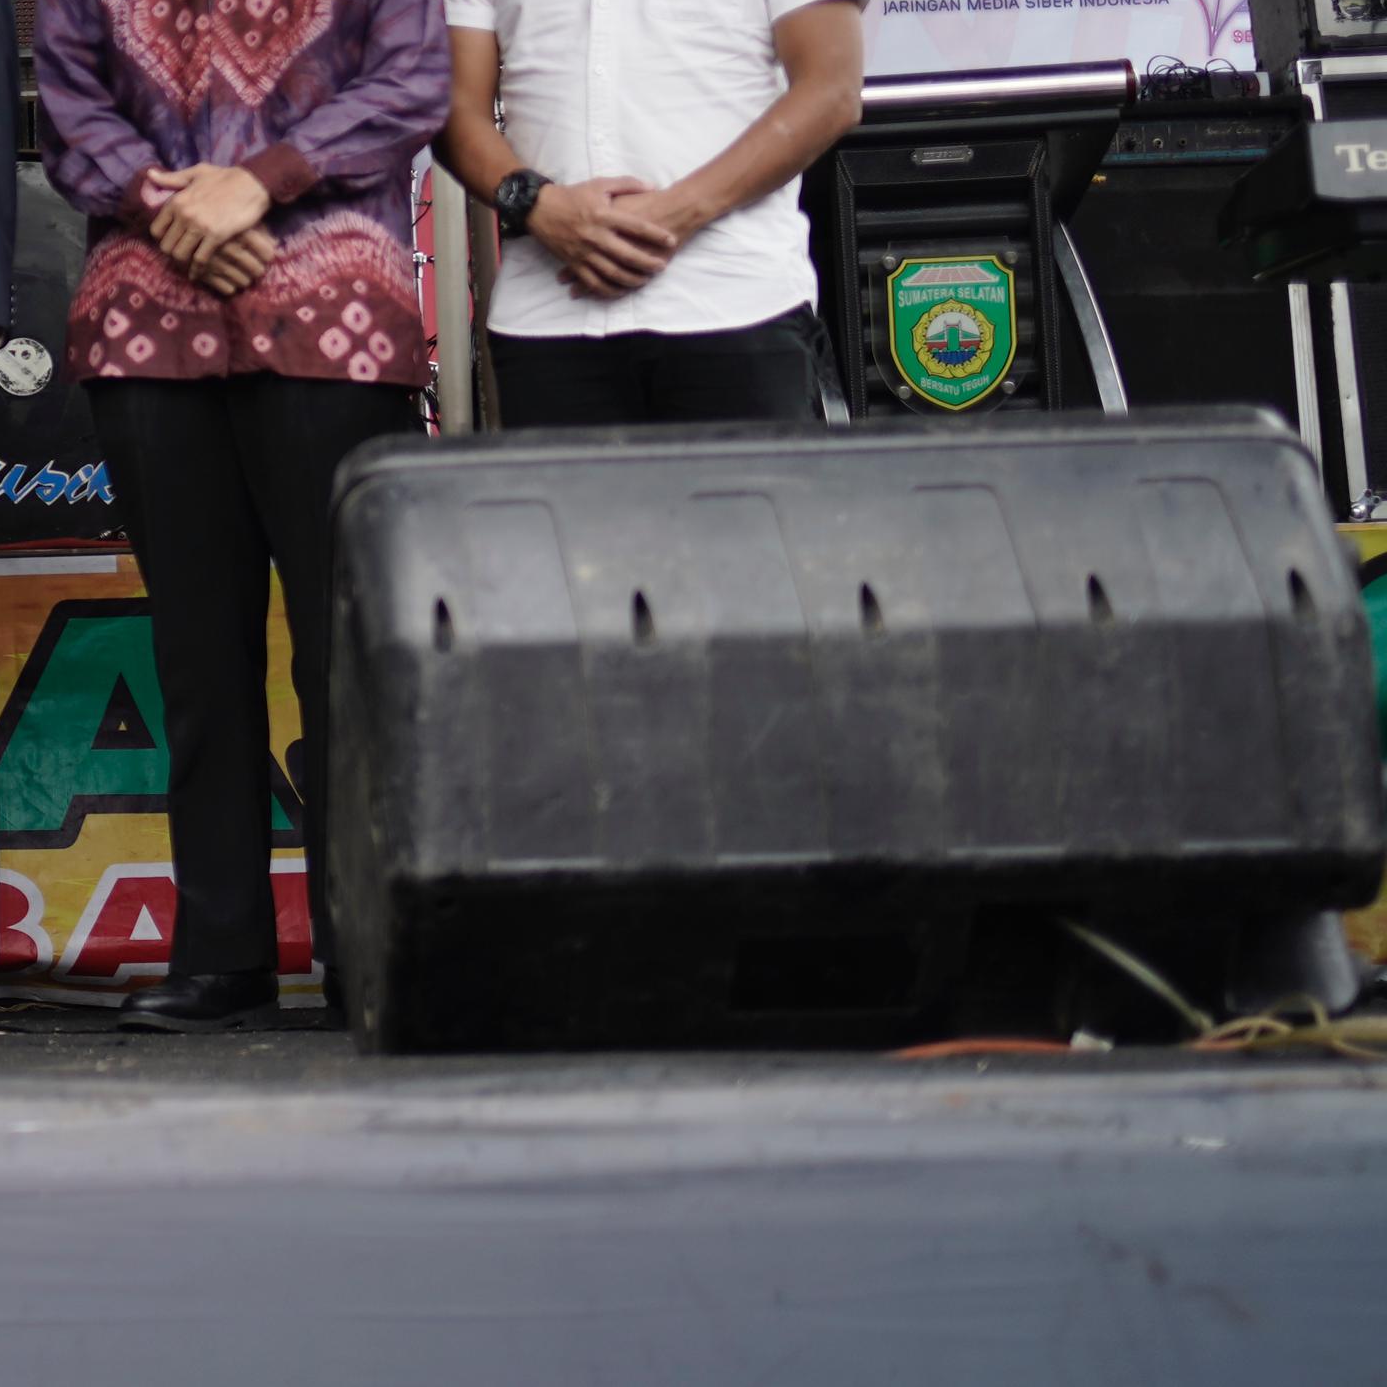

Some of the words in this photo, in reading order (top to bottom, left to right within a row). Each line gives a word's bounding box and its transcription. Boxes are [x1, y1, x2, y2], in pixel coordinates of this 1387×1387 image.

[898, 287, 955, 308] SUMATERA
[957, 286, 1005, 304] SELATAN
[921, 377, 960, 396] BERSATU
[962, 375, 990, 393] TEGUH
